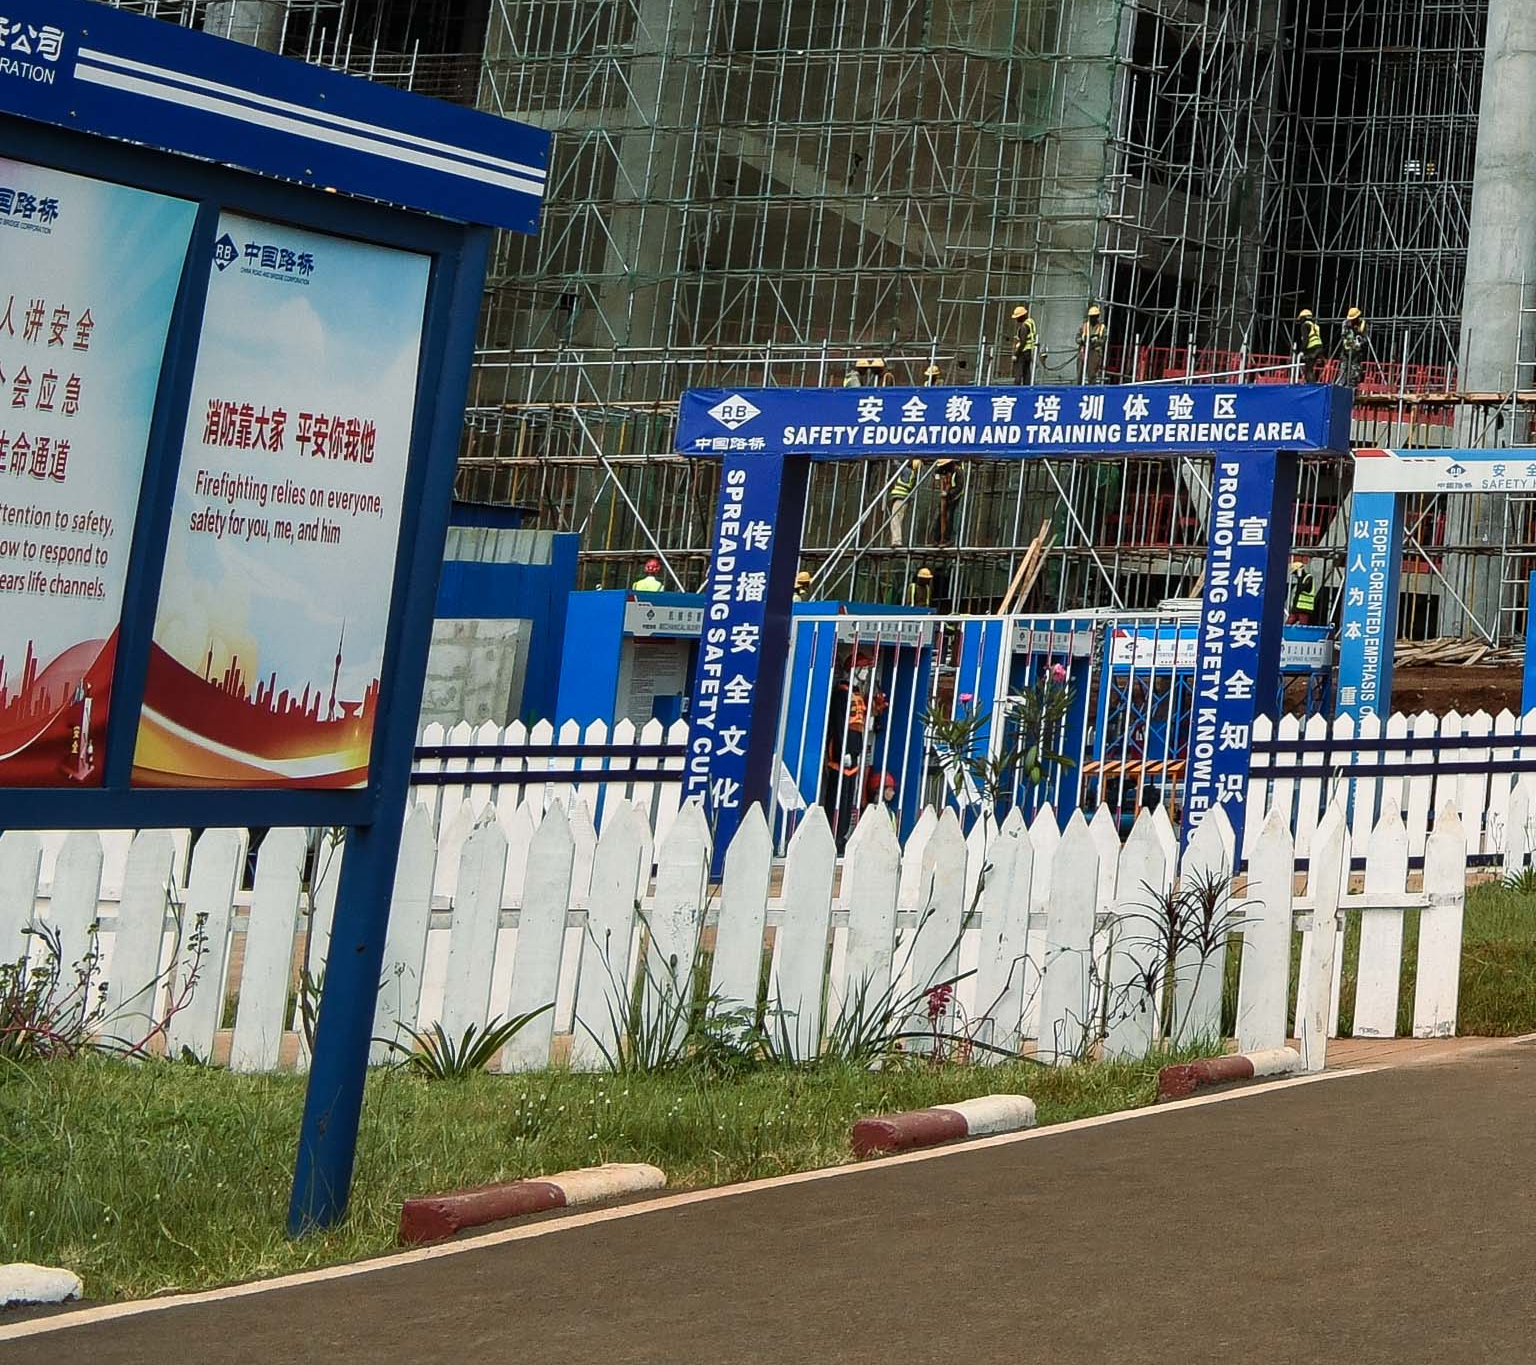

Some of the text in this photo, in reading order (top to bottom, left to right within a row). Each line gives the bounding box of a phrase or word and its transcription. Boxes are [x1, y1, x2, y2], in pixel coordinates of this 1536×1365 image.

[244, 241, 315, 277] 中国路桥
[721, 405, 747, 418] RB
[857, 394, 1238, 423] 安全教育培训体验区
[203, 399, 377, 463] 消防靠大家 平安你我他
[783, 422, 1306, 446] SAFETY EDUCATION AND TRAINING EXPERIENCE AREA
[195, 470, 385, 518] Firefighting relies on everyone,
[1482, 479, 1527, 489] SAFETY
[55, 510, 69, 528] to
[72, 511, 114, 538] safety,
[189, 506, 342, 544] safety for you, me, and him
[1209, 463, 1240, 604] PROMOTING
[23, 540, 37, 559] to
[40, 543, 93, 566] respond
[95, 547, 108, 565] to
[709, 469, 746, 621] SPREADING
[27, 571, 47, 592] life
[49, 573, 106, 598] channels.
[711, 520, 773, 809] 传播安全文化
[1199, 610, 1227, 702] SAFETY
[1214, 516, 1268, 806] 宣传安全知识
[697, 627, 727, 730] SAFETY
